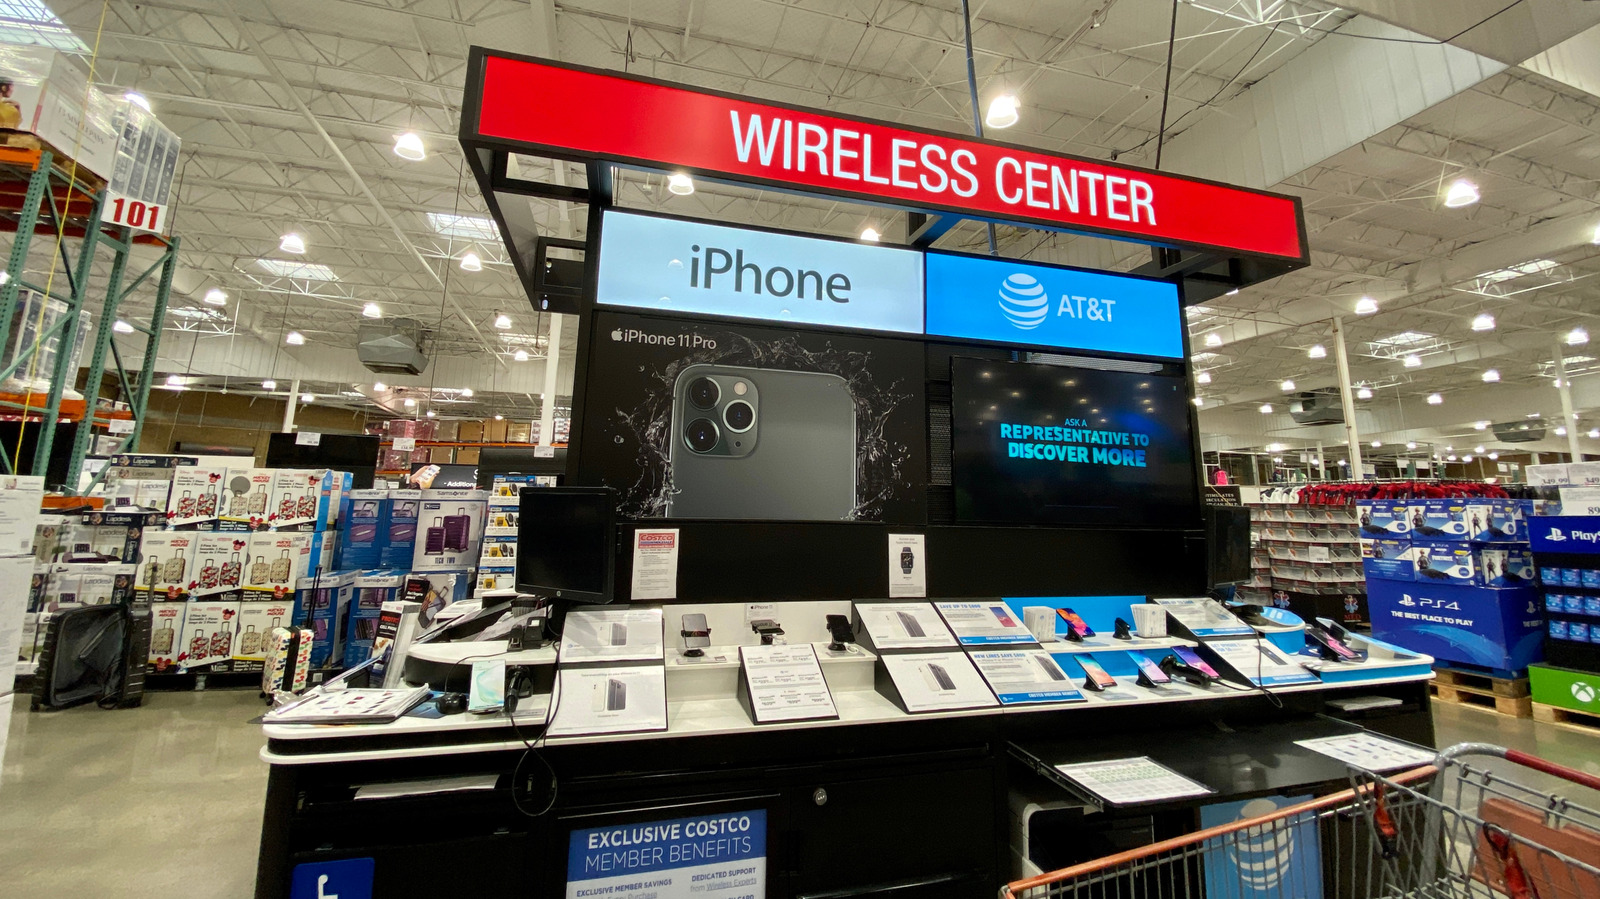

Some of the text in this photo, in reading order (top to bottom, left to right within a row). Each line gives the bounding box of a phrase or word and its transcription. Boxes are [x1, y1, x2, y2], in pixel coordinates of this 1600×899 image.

[730, 110, 1157, 226] WIRELESS CENTER
[113, 198, 160, 230] 101
[690, 244, 851, 303] iPhone
[1057, 294, 1117, 323] AT&T
[624, 329, 718, 350] iPhone 11 Pro
[1065, 418, 1087, 427] ASK A
[1000, 423, 1150, 447] REPRESENTATIVE TO
[1008, 442, 1147, 468] DISCOVER MORE
[640, 533, 674, 541] COSTCO
[1419, 598, 1460, 610] PS4
[1391, 610, 1404, 618] THE
[1405, 612, 1420, 620] BEST
[1421, 614, 1443, 623] PLACE
[1455, 618, 1474, 626] PLAY
[588, 816, 751, 850] EXCLUSIVE COSTCO
[585, 836, 752, 873] MEMBER BENEFITS
[690, 877, 757, 893] from Wireless Experts
[691, 867, 756, 882] DEDICATED SUPPORT
[576, 878, 673, 897] EXCLUSIVE MEMBER SAVINGS
